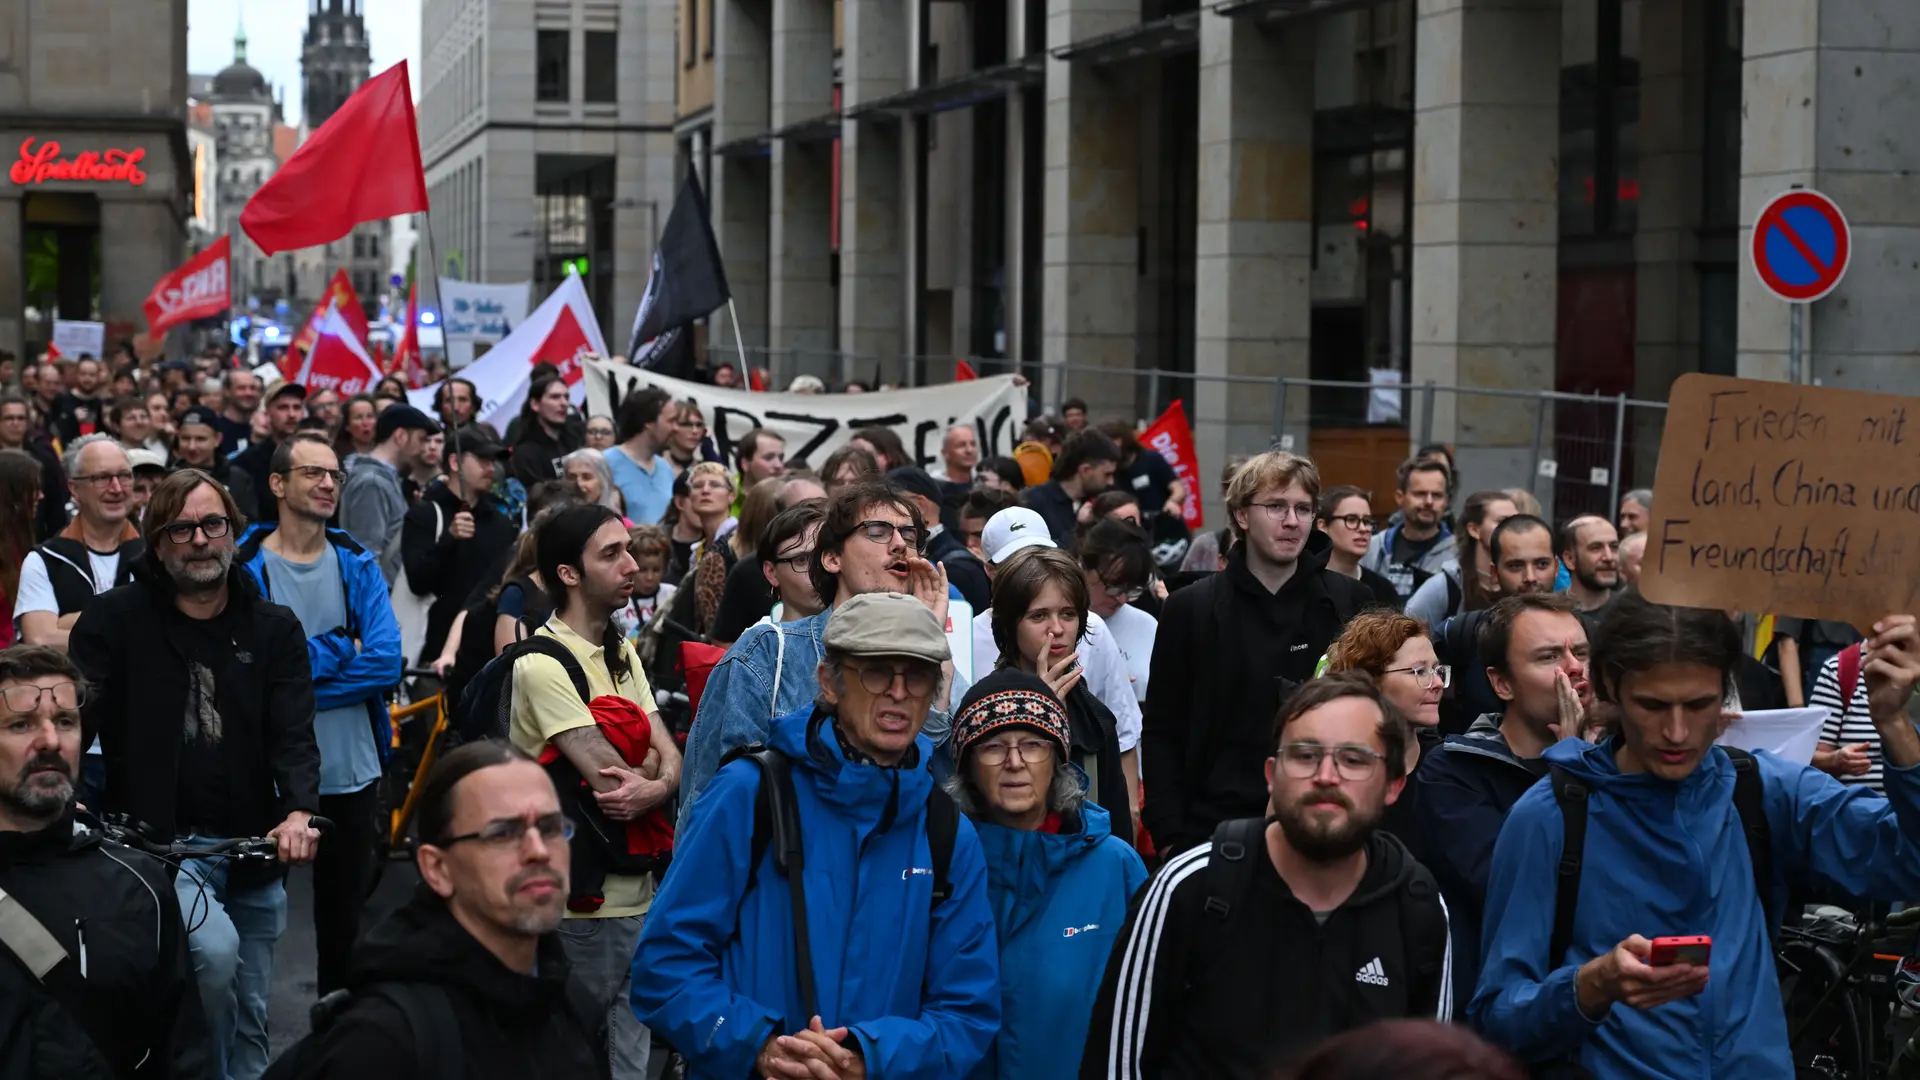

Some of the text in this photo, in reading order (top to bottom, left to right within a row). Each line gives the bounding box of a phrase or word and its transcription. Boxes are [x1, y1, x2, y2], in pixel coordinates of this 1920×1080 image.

[10, 136, 147, 184] Spielbank
[1704, 390, 1907, 451] Frieden mit
[1691, 457, 1761, 512] land,
[1773, 458, 1857, 508] China
[1659, 518, 1849, 586] Freundschaft
[1356, 972, 1389, 986] adidas
